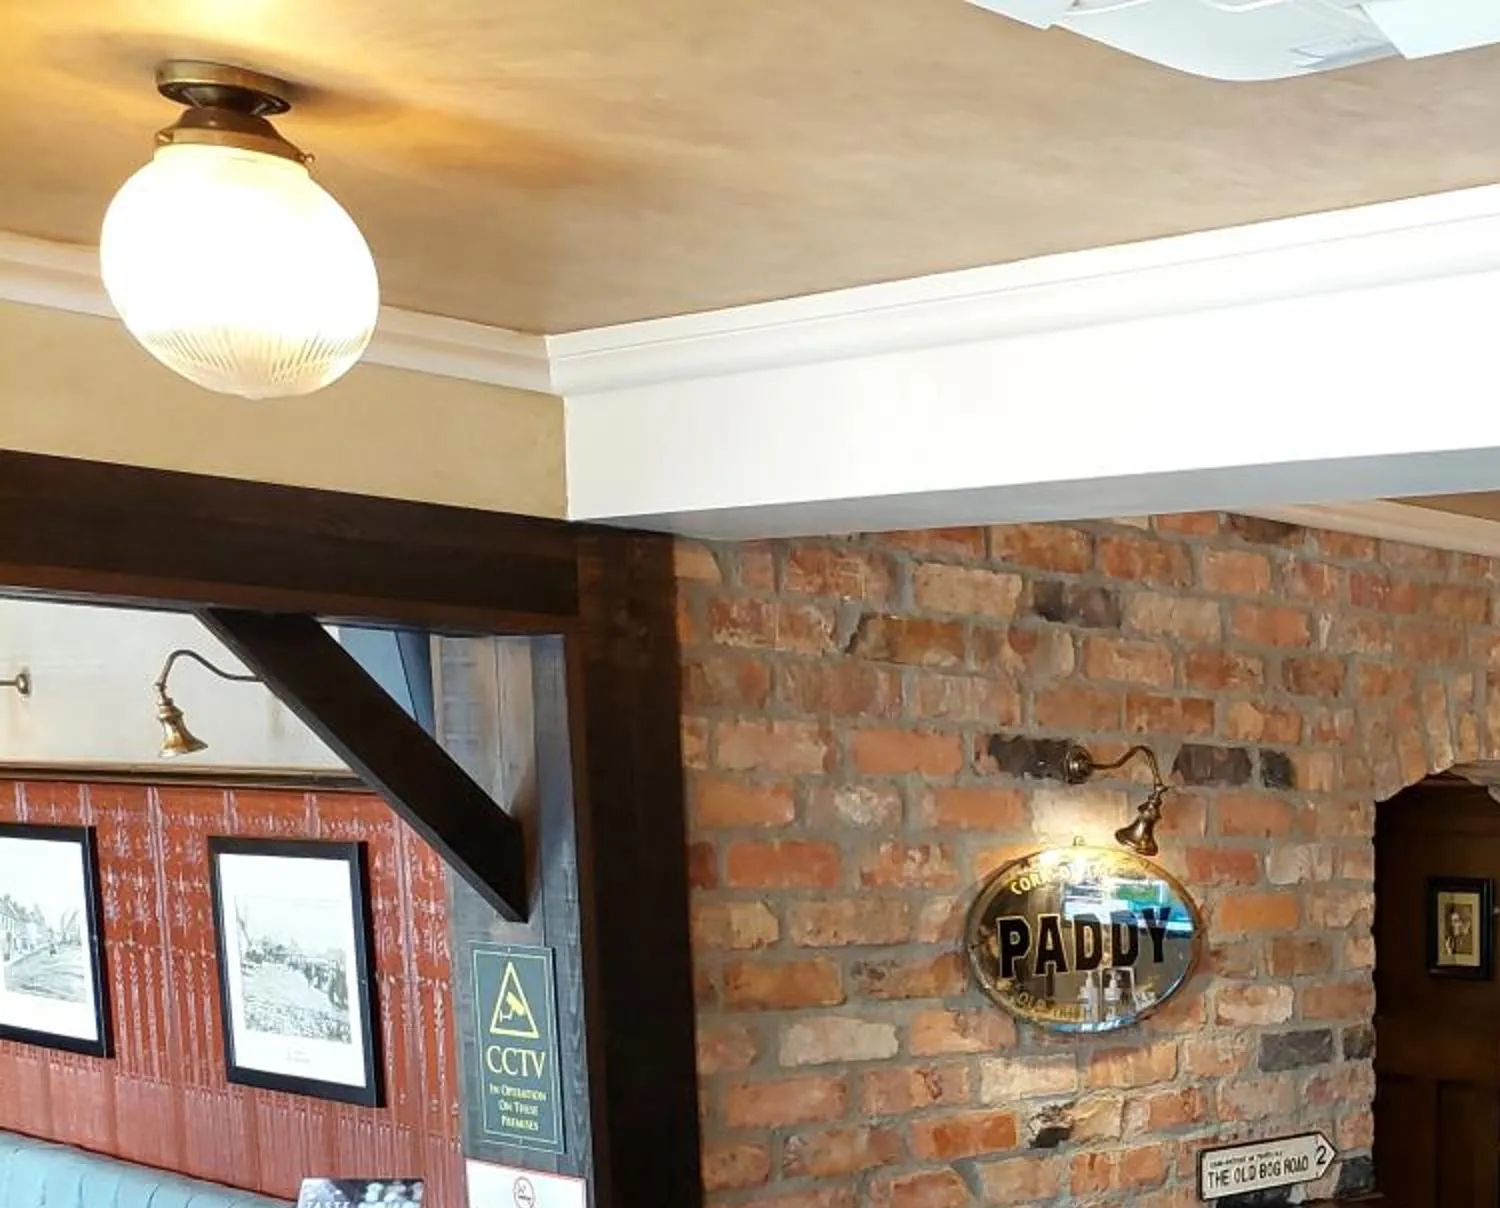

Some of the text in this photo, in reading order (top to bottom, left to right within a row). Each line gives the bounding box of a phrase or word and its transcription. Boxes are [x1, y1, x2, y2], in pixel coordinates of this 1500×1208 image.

[996, 907, 1171, 978] PADDY
[487, 1045, 545, 1079] CCTV
[1208, 1169, 1230, 1189] THE
[1234, 1165, 1256, 1184] OLD
[1260, 1161, 1281, 1179] BOG
[1284, 1155, 1309, 1175] ROAD
[1316, 1145, 1327, 1165] 2
